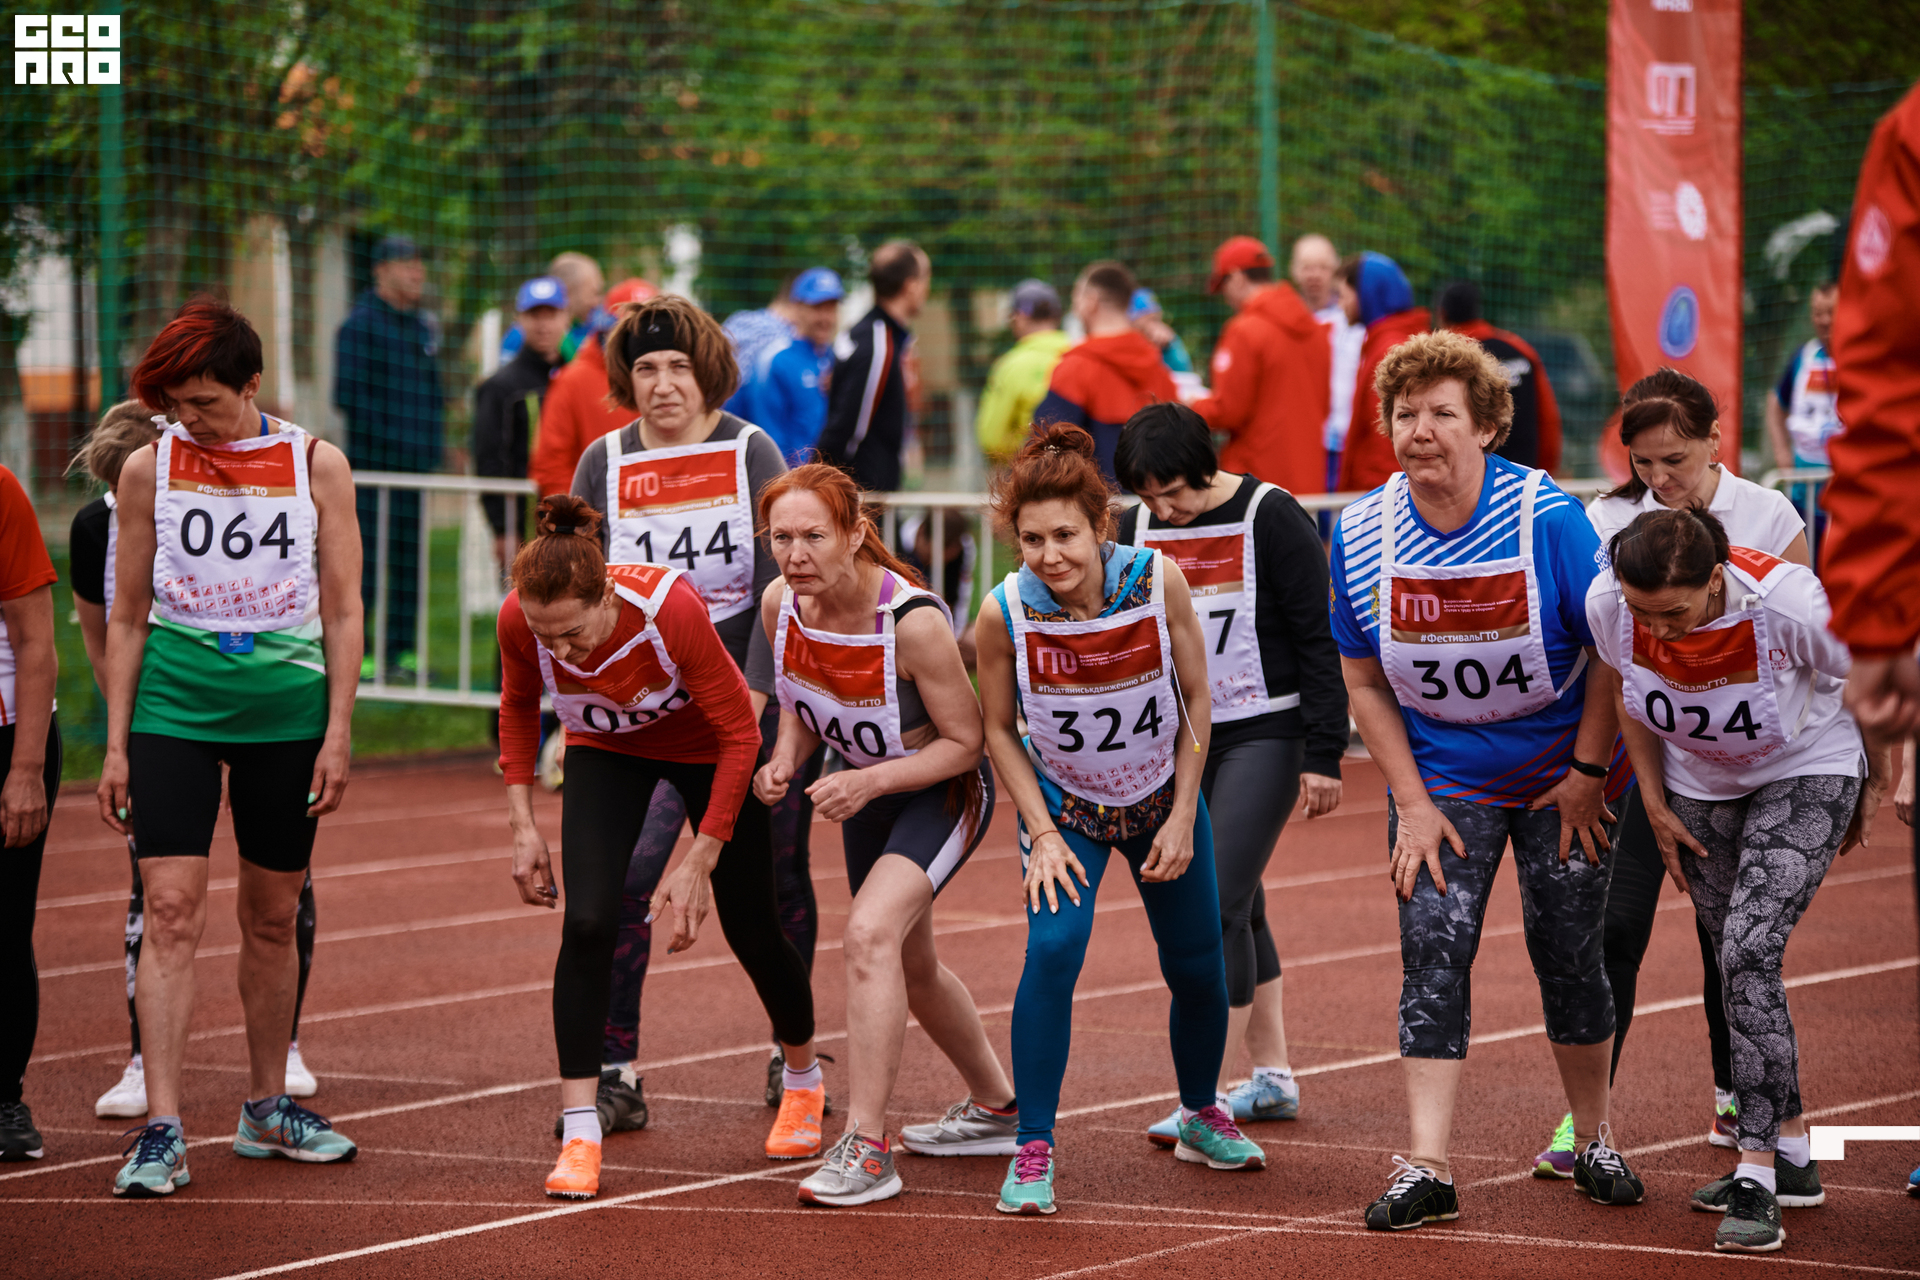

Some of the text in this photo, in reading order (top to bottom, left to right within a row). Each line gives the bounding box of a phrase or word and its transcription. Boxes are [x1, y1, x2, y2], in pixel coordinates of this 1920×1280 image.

[197, 484, 267, 496] #ФестивальГТО
[625, 471, 659, 500] ГТО
[713, 496, 735, 506] #ГТО
[181, 508, 295, 560] 064
[635, 521, 738, 570] 144
[1401, 593, 1440, 622] ГТО
[1420, 630, 1499, 644] #ФестивальГТО
[1037, 647, 1077, 675] ГТО
[1038, 669, 1160, 694] #Подтяниськдвижению #ГТО
[1412, 653, 1534, 701] 304
[859, 698, 881, 707] #ГТО
[1645, 690, 1762, 742] 024
[795, 700, 887, 758] 040
[1052, 695, 1163, 752] 324
